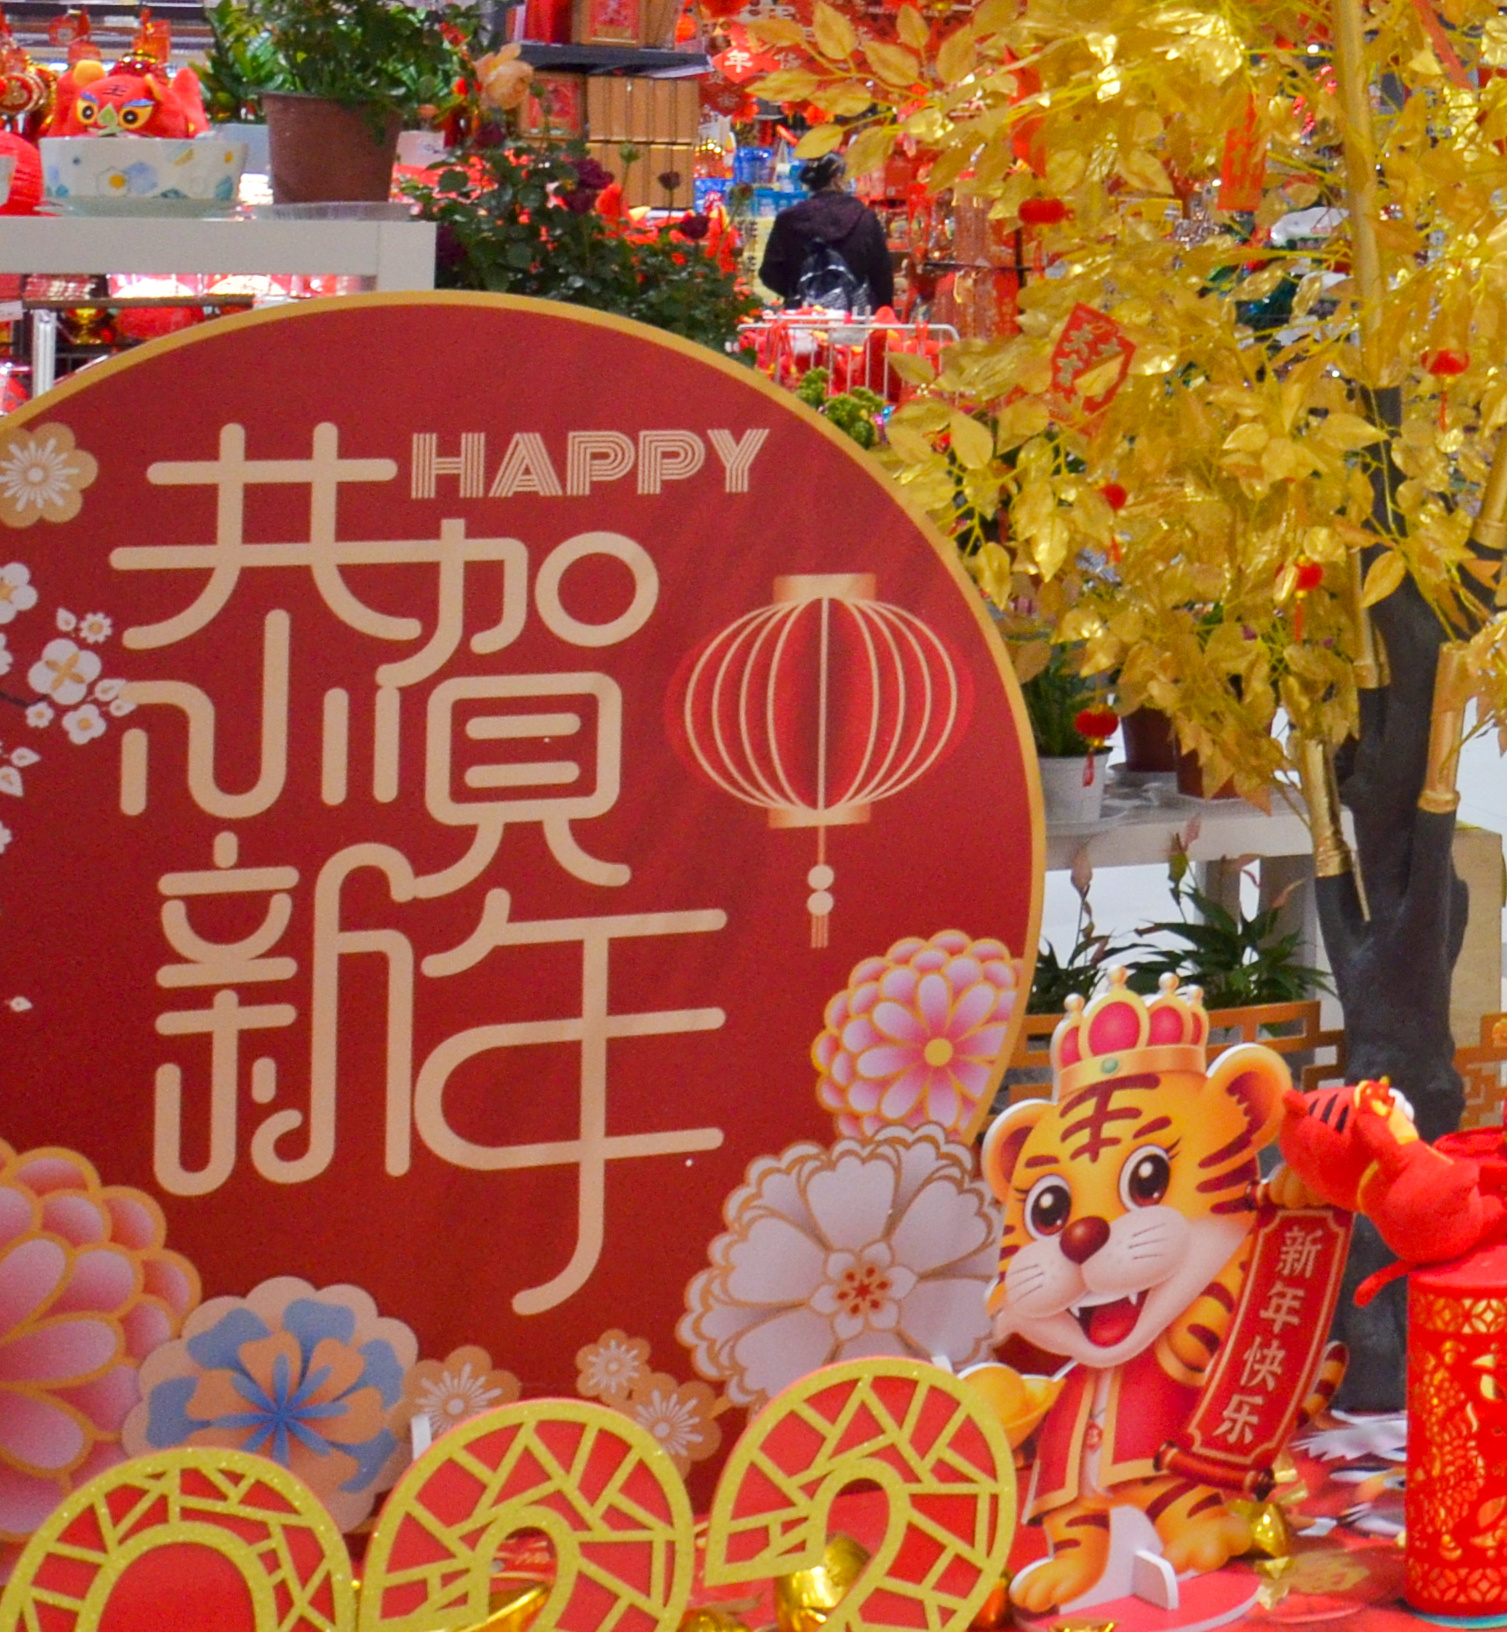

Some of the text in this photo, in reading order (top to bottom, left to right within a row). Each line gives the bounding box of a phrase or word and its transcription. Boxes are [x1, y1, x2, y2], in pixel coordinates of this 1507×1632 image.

[410, 428, 770, 499] HAPPY
[154, 831, 728, 1316] 新年
[1212, 1225, 1325, 1446] 新年快乐
